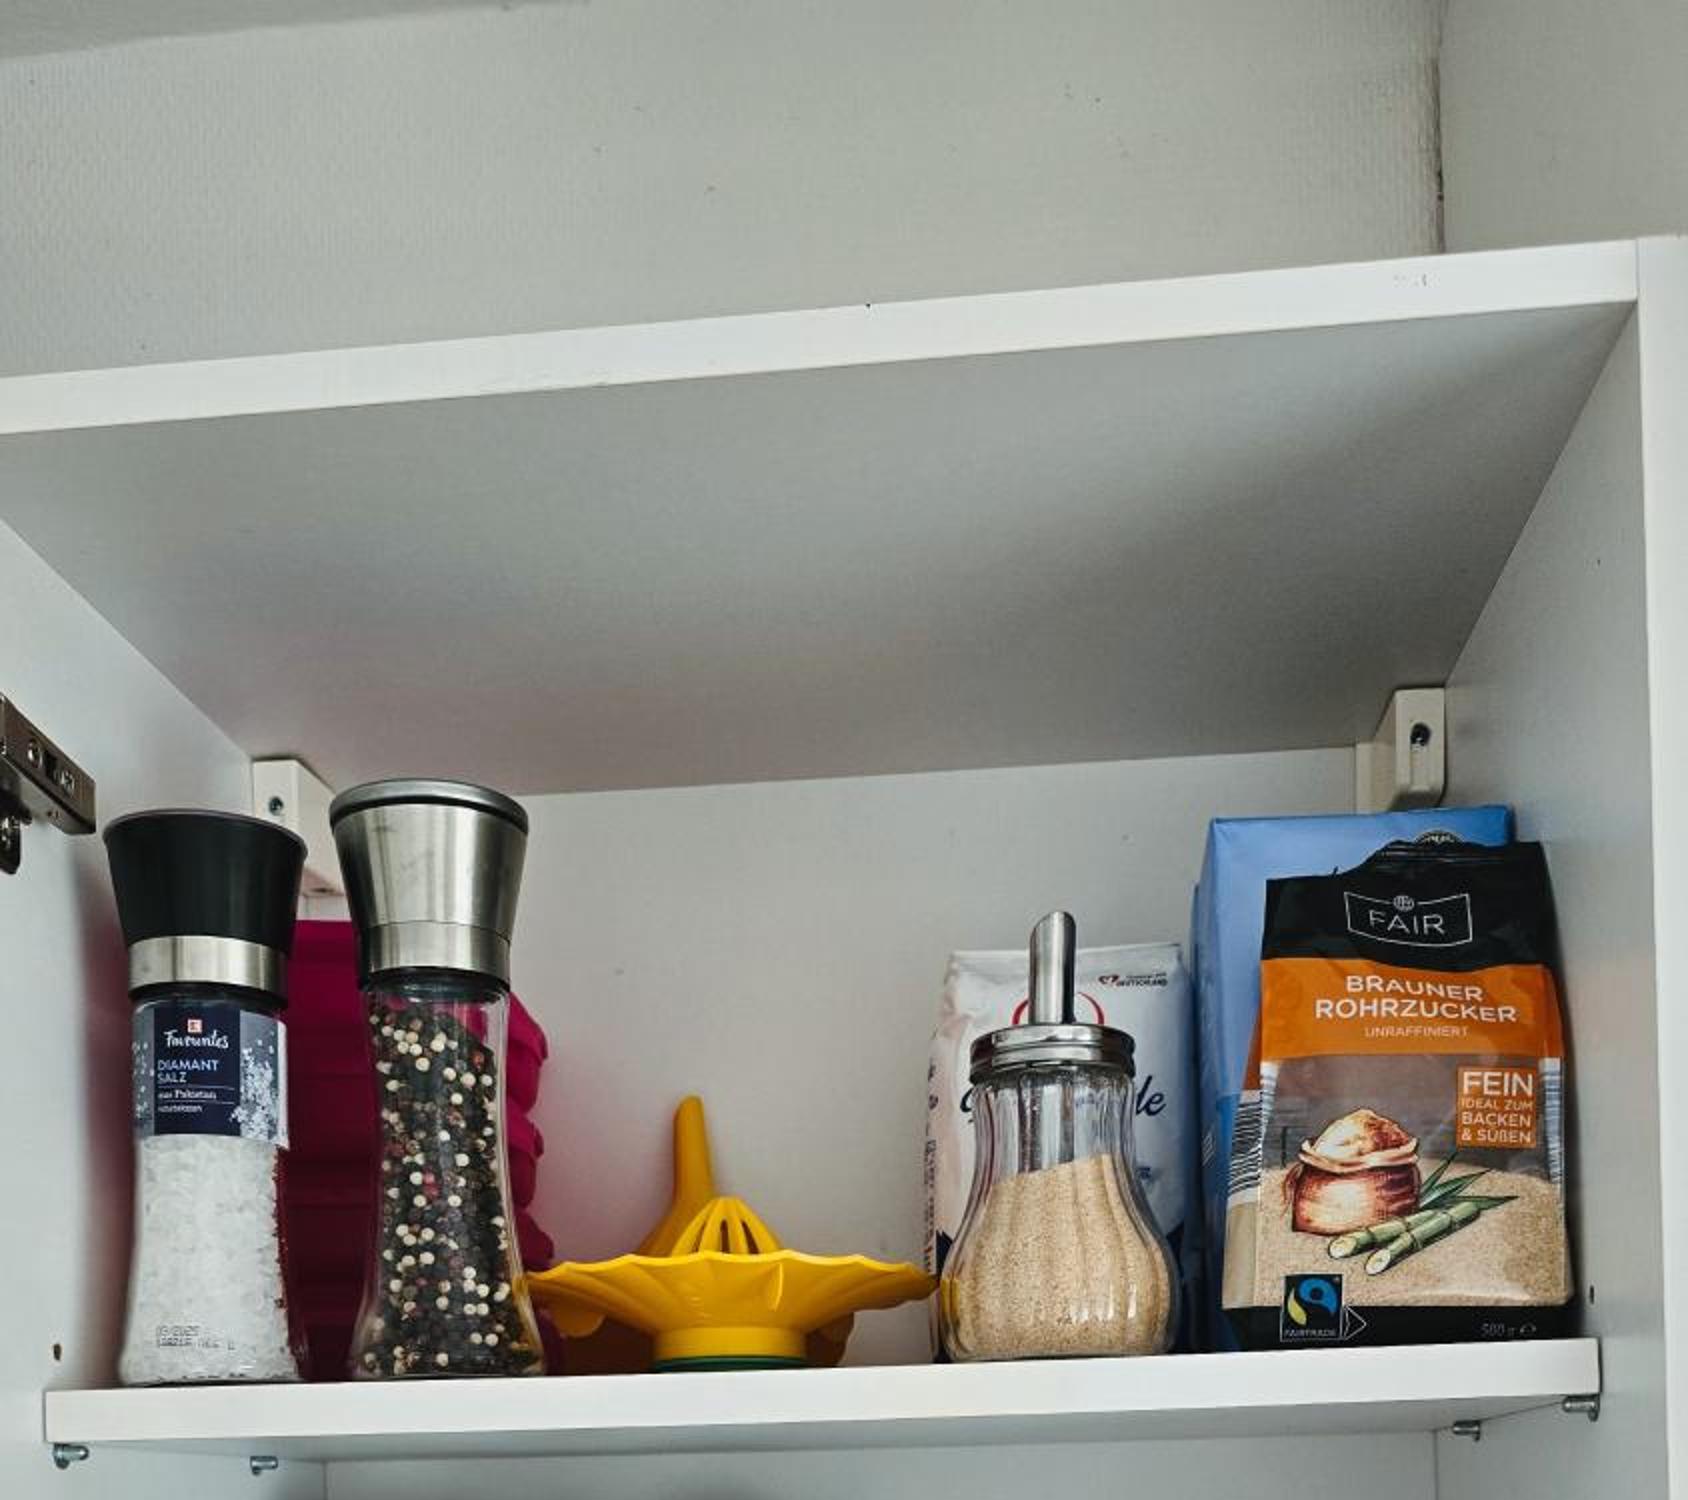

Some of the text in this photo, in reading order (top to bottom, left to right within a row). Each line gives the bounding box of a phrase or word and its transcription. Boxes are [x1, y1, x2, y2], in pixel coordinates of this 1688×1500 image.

[1369, 909, 1445, 935] FAIR
[1345, 975, 1484, 1002] BRAUNER
[1314, 998, 1518, 1023] ROHRZUCKER
[1364, 1026, 1469, 1038] UNRAFFINIERT
[157, 1059, 219, 1071] DIAMANT
[157, 1071, 187, 1083] SALZ
[1463, 1071, 1533, 1097] FEIN
[1461, 1098, 1533, 1111] IDEAL ZUM
[1461, 1111, 1532, 1128] BACKEN
[1461, 1127, 1472, 1141] &
[1481, 1322, 1505, 1337] 500
